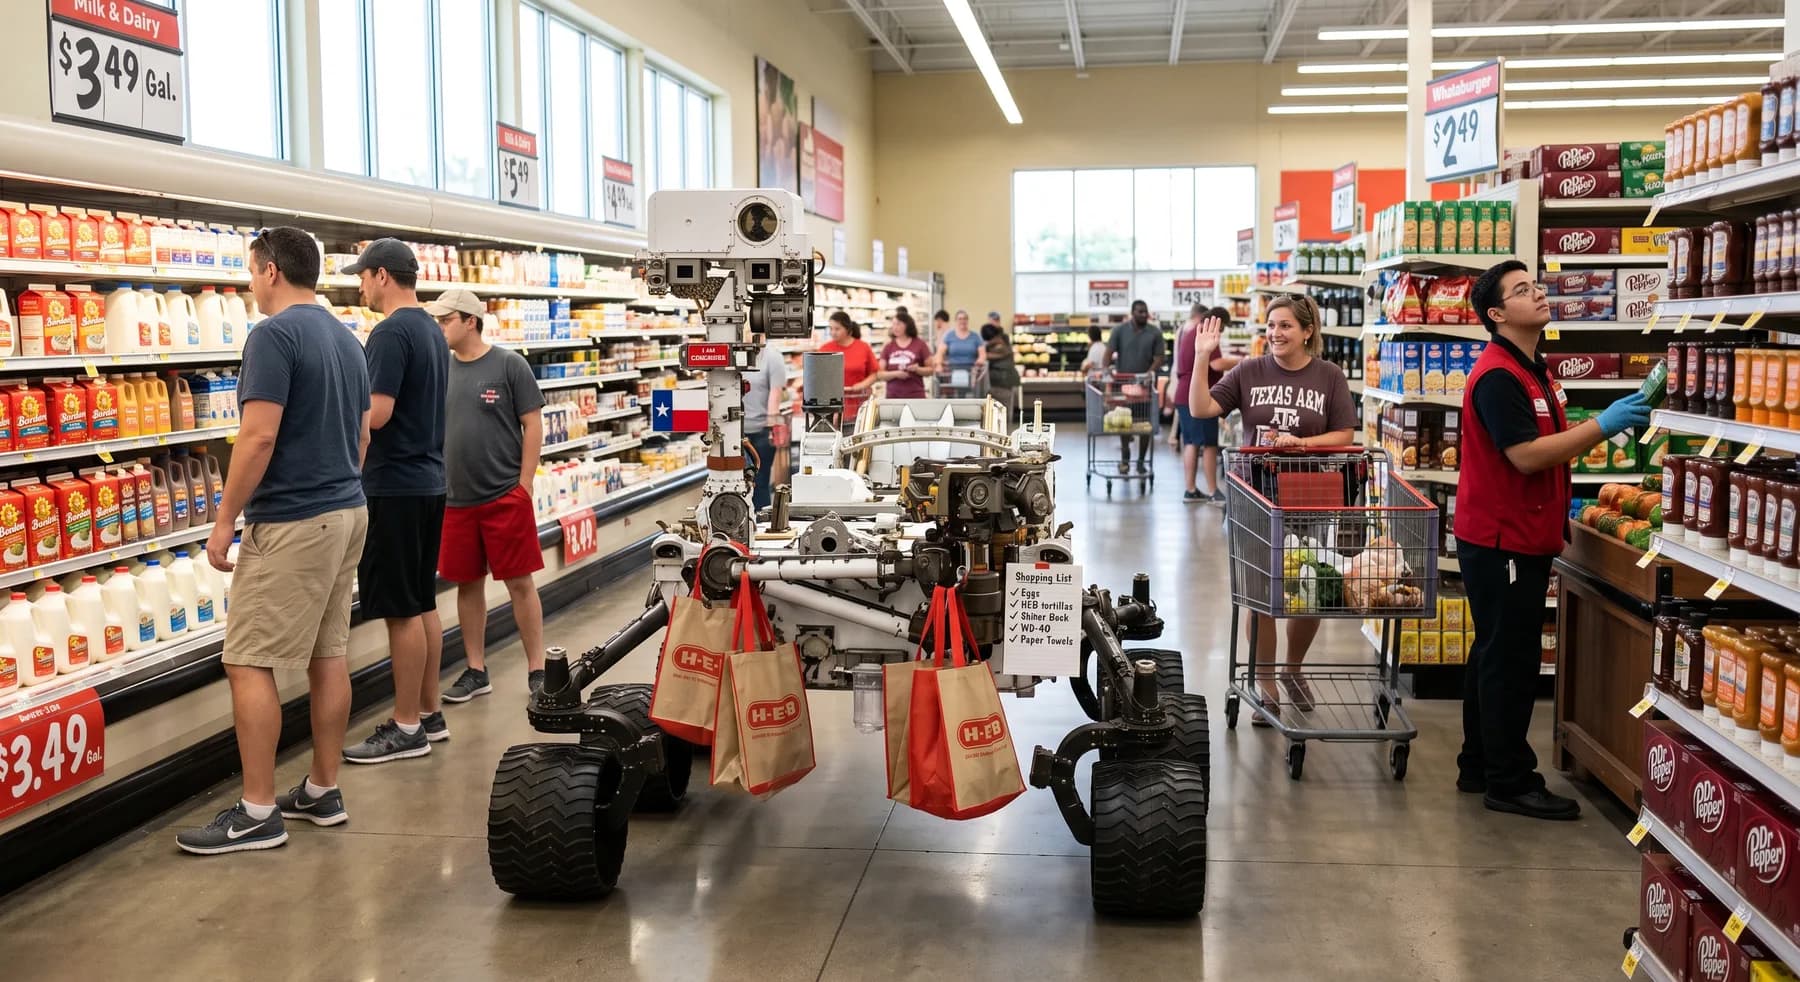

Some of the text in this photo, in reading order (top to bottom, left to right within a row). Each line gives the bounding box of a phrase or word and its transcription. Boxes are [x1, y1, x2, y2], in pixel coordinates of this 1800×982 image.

[74, 0, 160, 39] Milk & Dairy
[146, 68, 176, 101] Gal.
[1432, 75, 1492, 103] Whataburger
[1628, 275, 1658, 292] Pepper
[1637, 273, 1650, 281] Dr
[1250, 385, 1325, 416] TEXAS A&M
[1016, 572, 1072, 584] Shopping List
[1021, 588, 1040, 599] Eggs
[1021, 600, 1073, 611] HEB tortillas
[1021, 612, 1069, 622] Shiner Bock
[1021, 623, 1051, 633] WD-40
[1021, 635, 1073, 646] Paper Towels
[1658, 744, 1668, 762] Dr
[1650, 746, 1672, 784] Pepper
[1705, 780, 1716, 800] Dr
[1696, 782, 1722, 824] Pepper
[1760, 826, 1773, 847] Dr
[1749, 828, 1781, 873] Pepper
[1656, 882, 1666, 900] Dr
[1649, 884, 1671, 924] Pepper
[1708, 936, 1721, 958] Dr
[1700, 936, 1727, 980] Pepper
